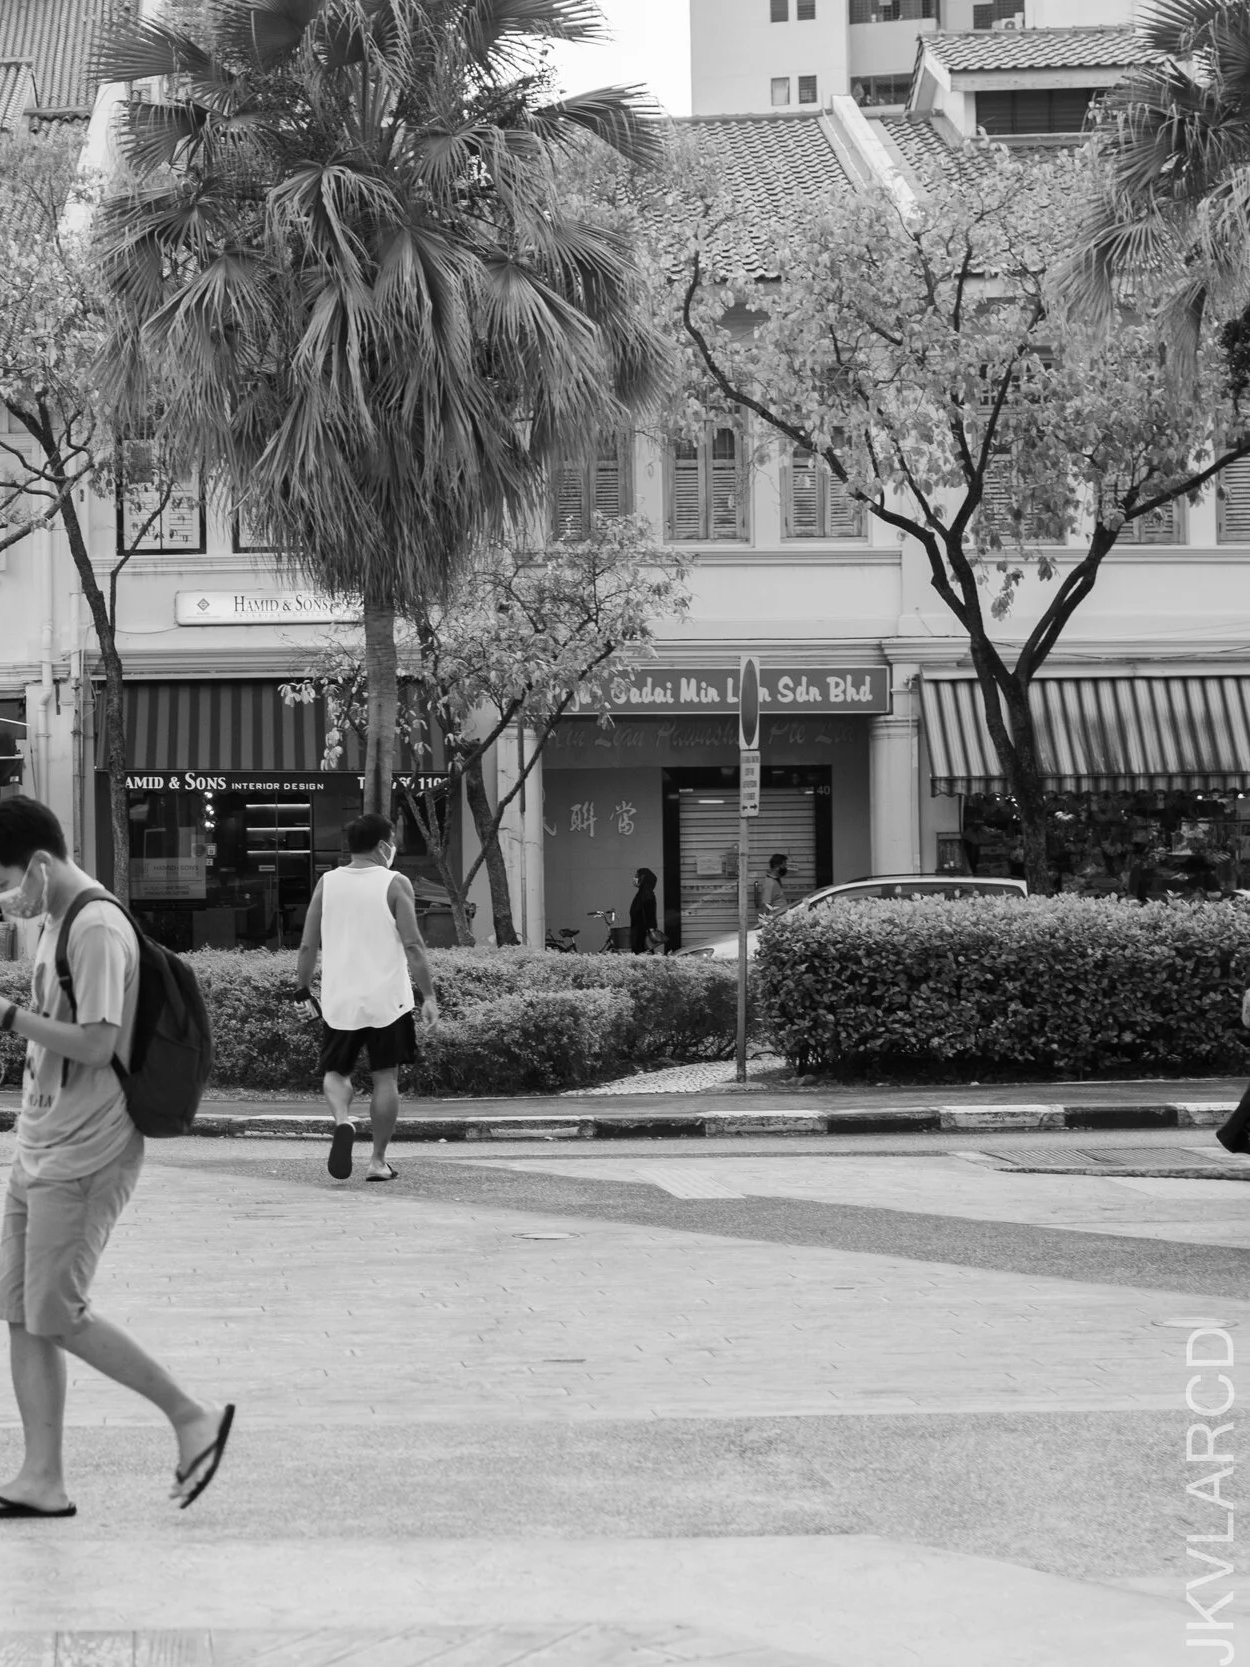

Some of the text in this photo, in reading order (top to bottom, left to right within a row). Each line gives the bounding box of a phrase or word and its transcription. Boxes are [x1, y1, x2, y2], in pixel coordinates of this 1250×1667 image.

[234, 594, 328, 612] HAMID & SONS
[680, 677, 721, 703] Min
[727, 677, 771, 703] Ln
[777, 676, 822, 703] Sdn
[826, 675, 873, 702] Bhd
[125, 776, 164, 789] AMID
[168, 776, 180, 789] &
[184, 772, 227, 790] SONS
[283, 782, 325, 790] DESIGN
[816, 785, 831, 796] 40
